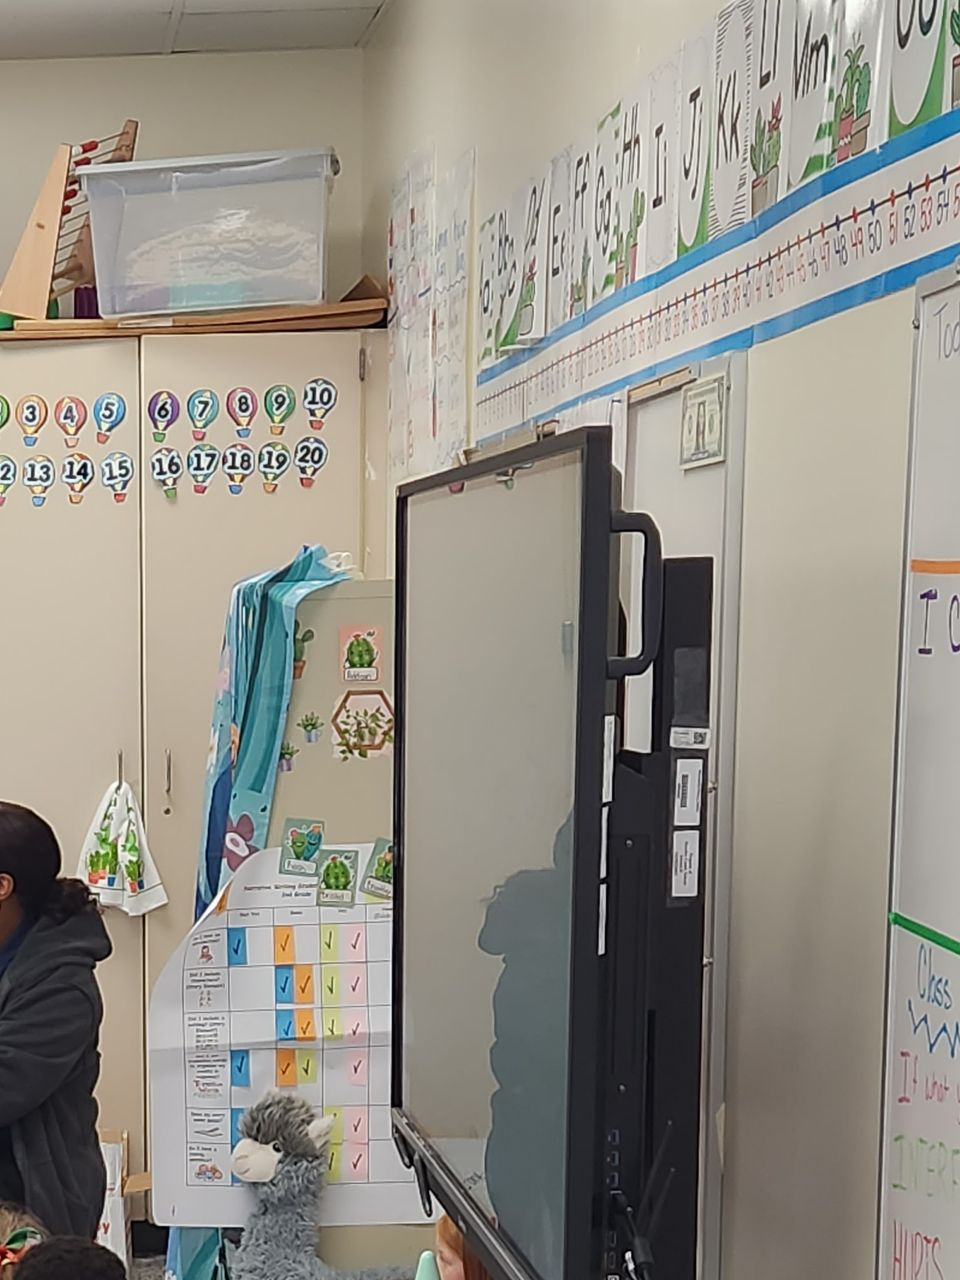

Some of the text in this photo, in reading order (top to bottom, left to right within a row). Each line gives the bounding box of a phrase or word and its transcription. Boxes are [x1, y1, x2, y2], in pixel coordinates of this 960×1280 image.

[620, 102, 640, 190] Hh
[683, 87, 703, 200] Jj
[716, 70, 741, 169] Kk
[652, 123, 667, 209] Ii
[594, 166, 612, 257] Gg
[820, 240, 830, 272] 47
[834, 234, 848, 266] 48
[851, 227, 865, 260] 49
[868, 218, 882, 254] 50
[889, 210, 899, 245] 51
[904, 203, 916, 239] 52
[920, 196, 933, 232] 53
[937, 187, 950, 225] 54
[24, 405, 37, 422] 3
[63, 405, 76, 423] 4
[102, 402, 115, 420] 5
[157, 386, 332, 419] 6 7 8 9 10
[27, 464, 51, 482] 13
[66, 461, 89, 480] 14
[105, 459, 130, 481] 15
[156, 445, 323, 476] 16 17 18 19 20
